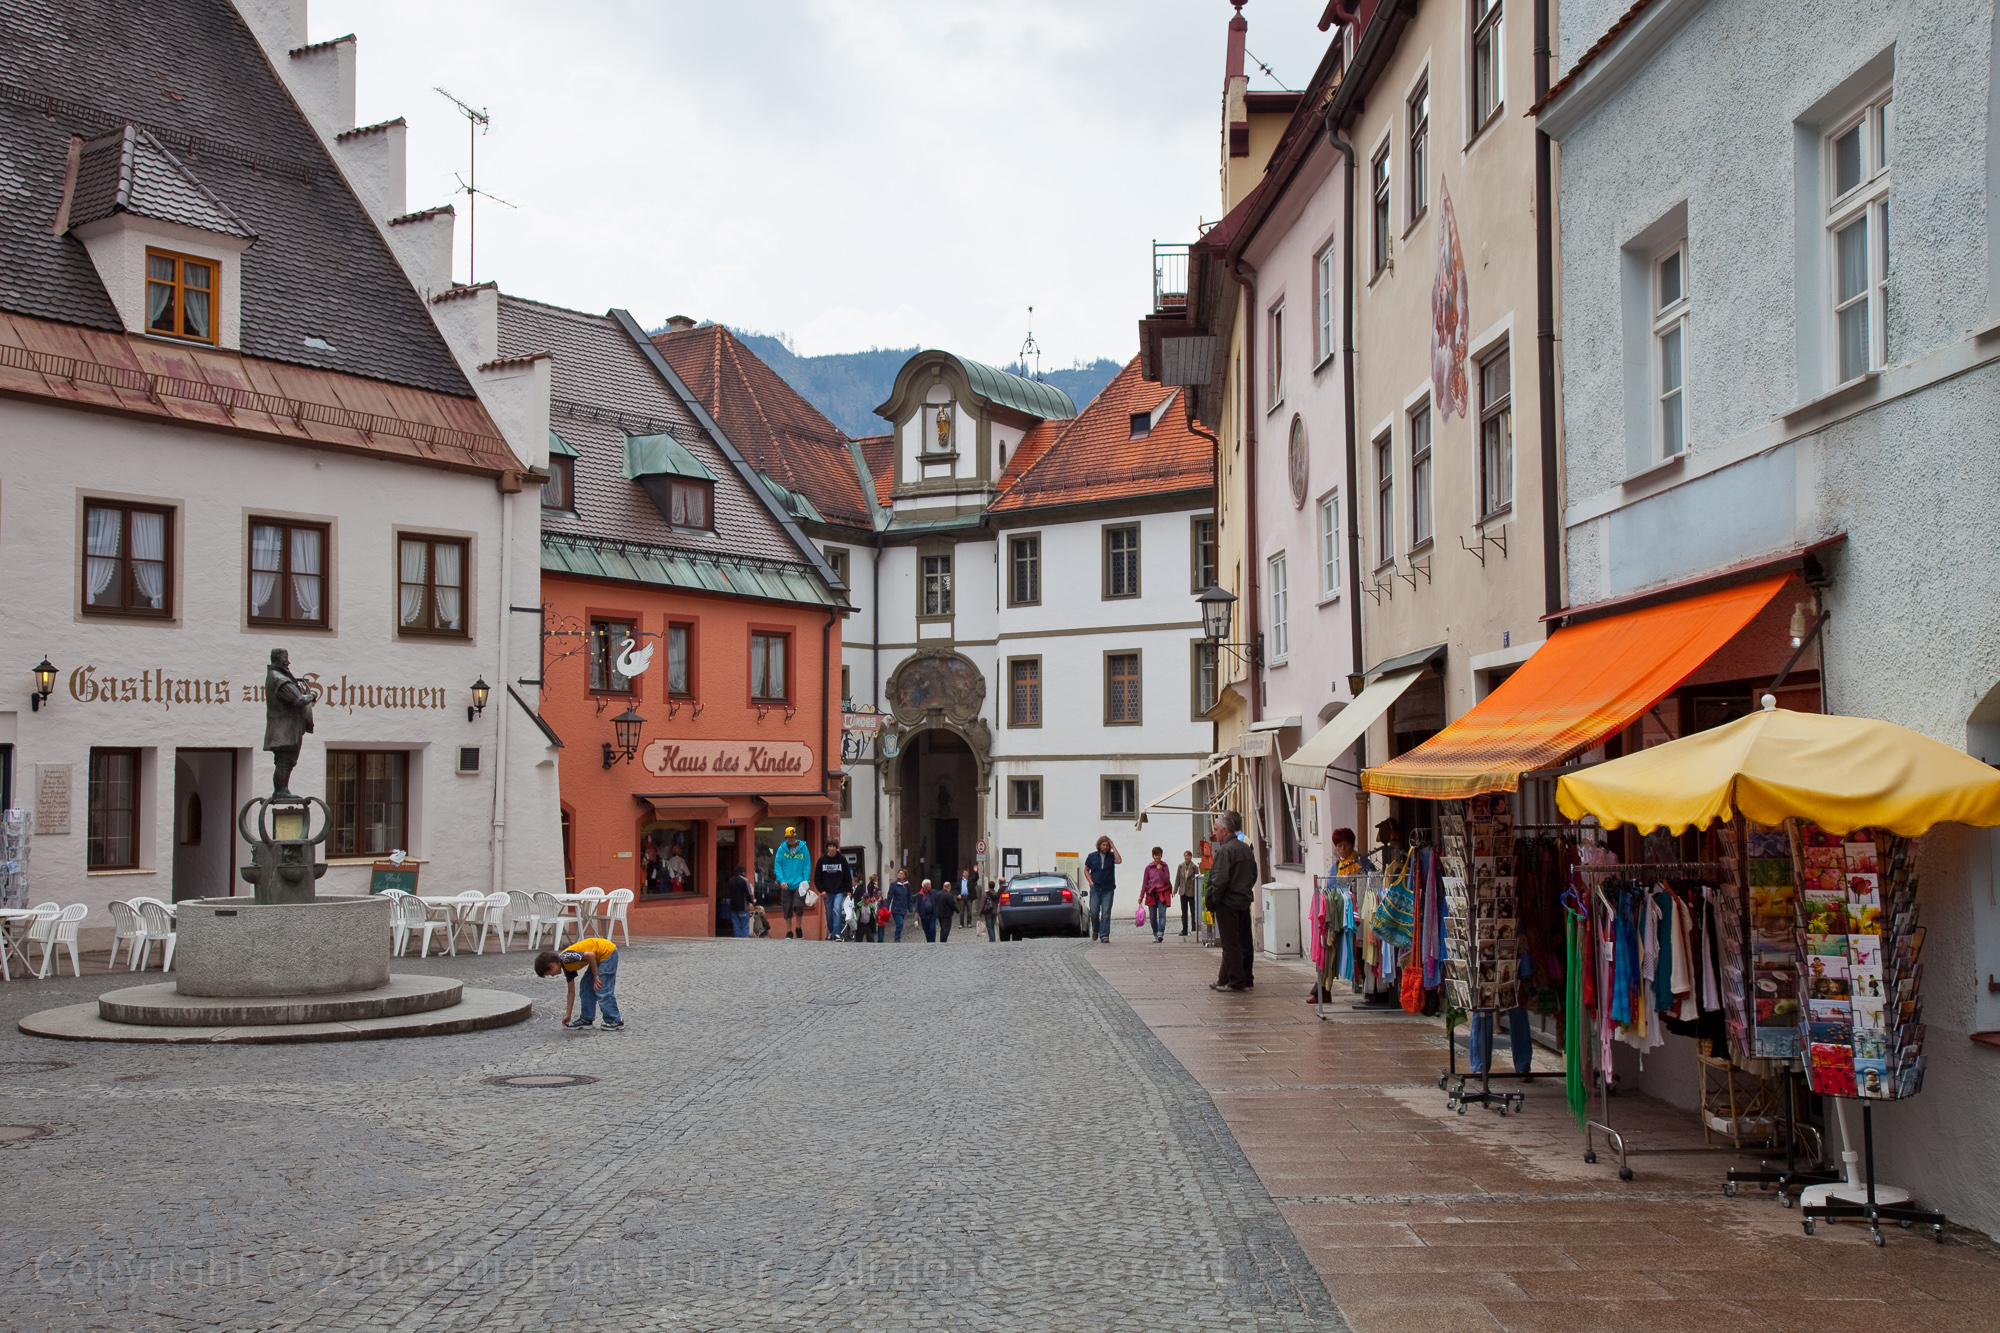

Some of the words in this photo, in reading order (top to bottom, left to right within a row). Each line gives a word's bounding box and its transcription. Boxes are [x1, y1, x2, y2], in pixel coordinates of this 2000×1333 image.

[69, 665, 230, 711] Gasthaus
[242, 684, 268, 703] zu
[302, 672, 446, 715] Schwanen
[659, 745, 707, 772] Haus
[712, 750, 739, 772] des
[744, 746, 802, 773] Kindes
